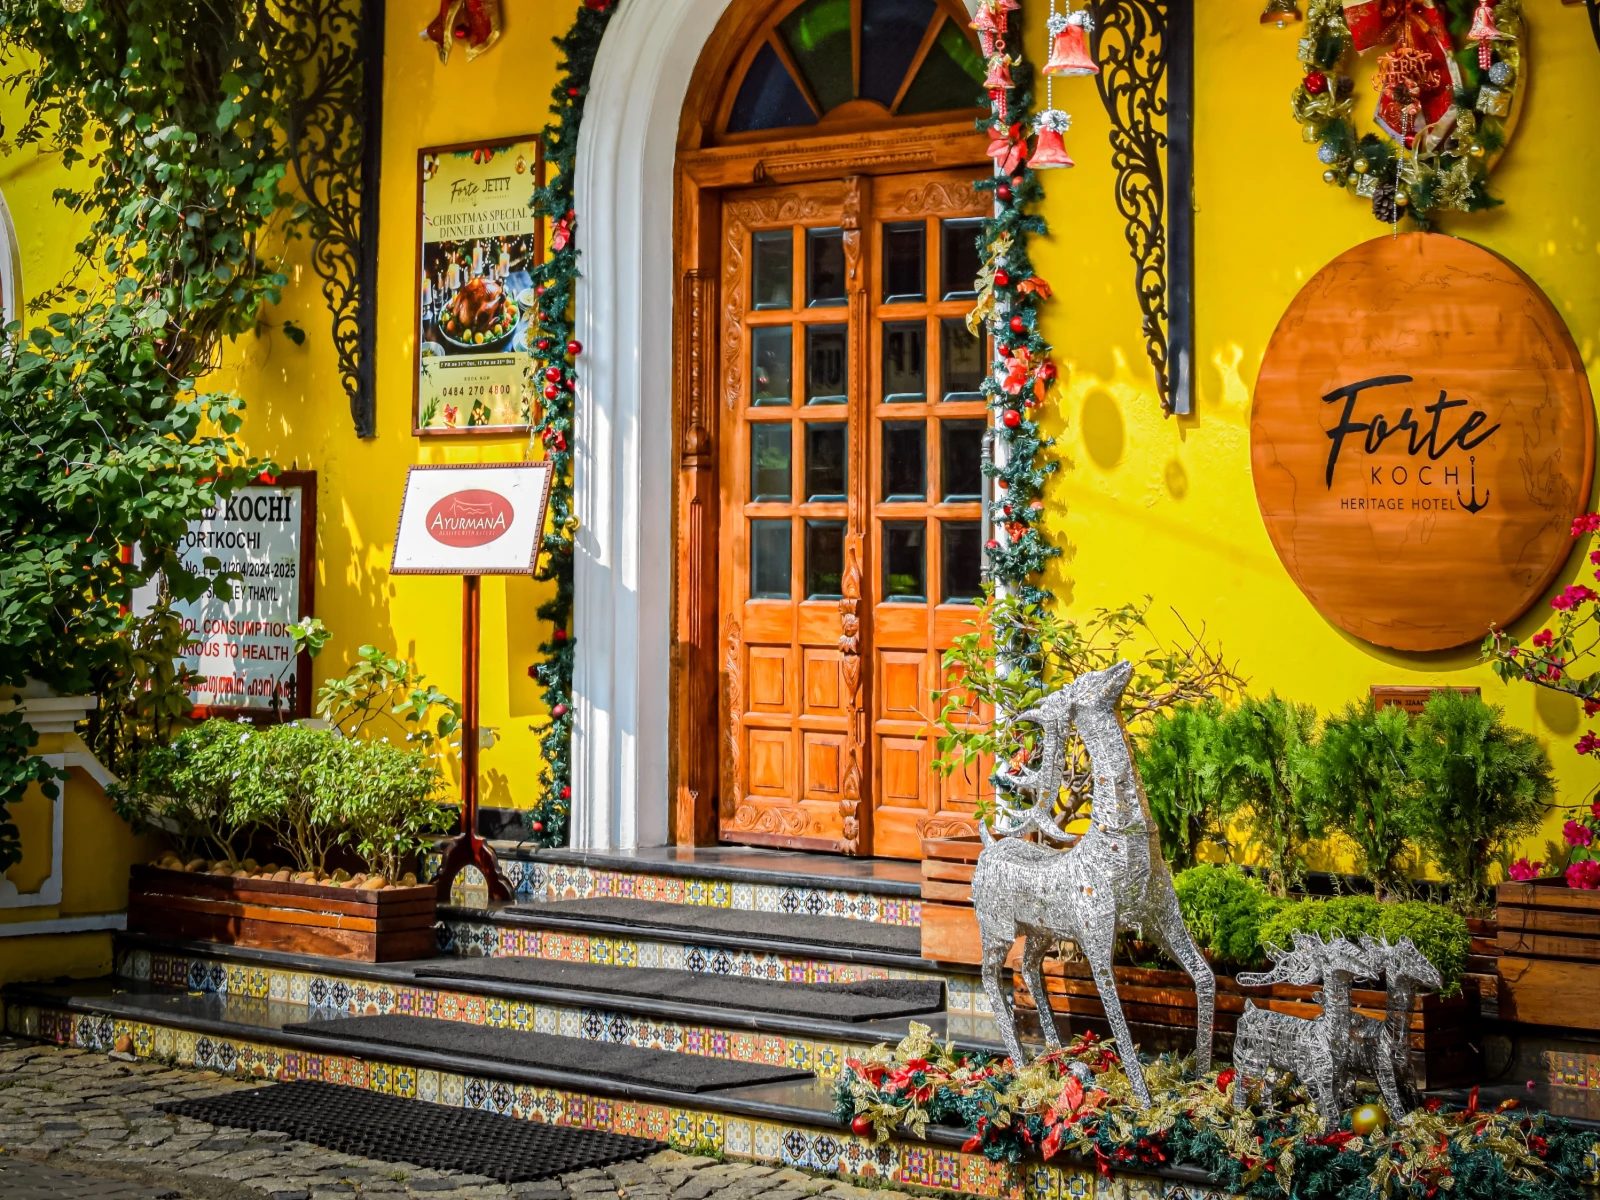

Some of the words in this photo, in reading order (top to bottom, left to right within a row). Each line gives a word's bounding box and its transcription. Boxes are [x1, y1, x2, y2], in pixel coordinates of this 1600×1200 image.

[1377, 58, 1428, 74] MERRY
[450, 178, 480, 204] Forte
[482, 176, 511, 193] JETTY
[432, 211, 488, 227] CHRISTMAS
[489, 207, 528, 222] SPECIAL
[440, 224, 475, 239] DINNER
[477, 224, 485, 236] &
[487, 220, 520, 235] LUNCH
[442, 386, 464, 397] 0484
[468, 385, 485, 396] 270
[488, 384, 511, 395] 4800
[1321, 374, 1501, 491] Forte
[1371, 456, 1476, 486] KOCHI
[224, 496, 292, 522] KOCHI
[1340, 497, 1405, 510] HERITAGE
[1411, 498, 1456, 511] HOTEL
[178, 531, 260, 549] FORTKOCHI
[248, 585, 278, 601] THAYIL
[203, 619, 290, 638] CONSUMPTION
[223, 643, 239, 658] TO
[242, 644, 289, 662] HEALTH
